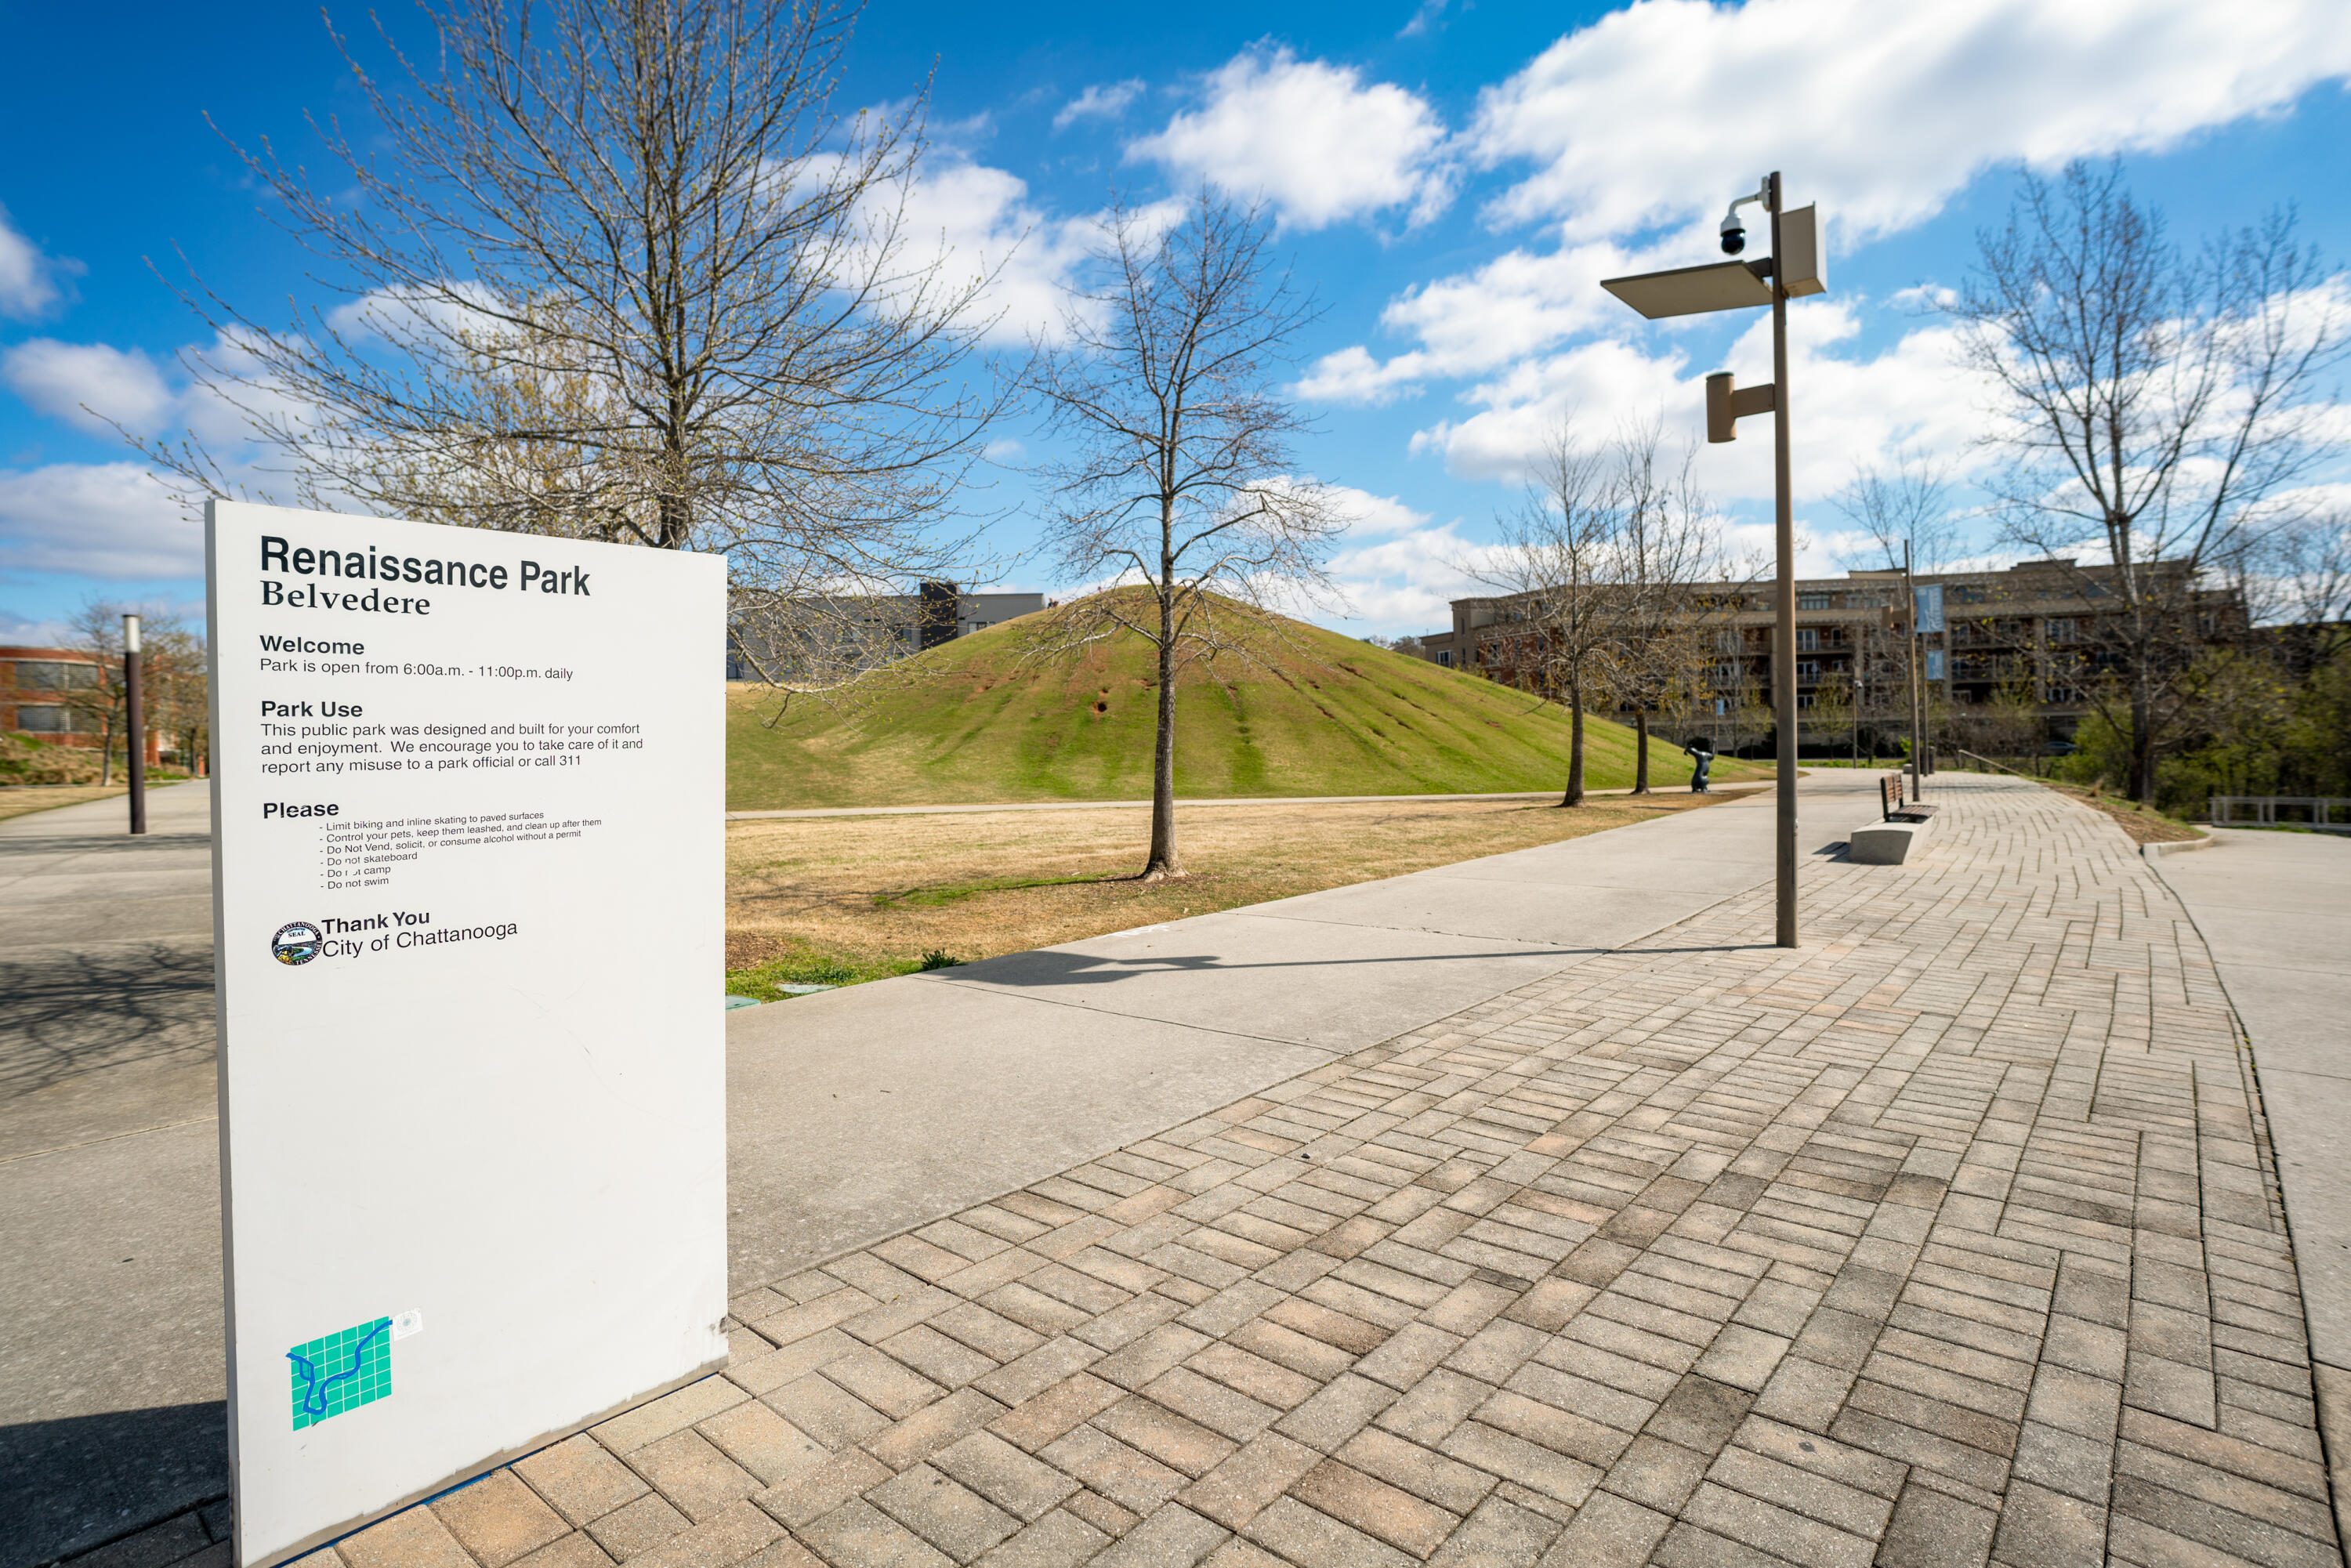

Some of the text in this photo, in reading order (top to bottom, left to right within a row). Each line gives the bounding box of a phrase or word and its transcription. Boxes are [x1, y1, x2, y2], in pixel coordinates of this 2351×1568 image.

[260, 534, 591, 596] Renaissance Park
[259, 580, 430, 615] Belvedere
[259, 634, 365, 655] Welcome
[260, 657, 299, 672] Park
[303, 659, 317, 672] is
[321, 663, 360, 676] open
[364, 661, 399, 675] from
[403, 663, 465, 676] 6:00a.m.
[479, 665, 542, 681] 11:00p.m.
[545, 667, 574, 683] daily
[261, 700, 364, 718] Park Use
[259, 722, 640, 740] This public park was designed and built for your comfort
[260, 738, 643, 758] and enjoyment. We encourage you to take care of it and
[262, 755, 580, 777] report any misuse to a park official or call 311
[263, 802, 339, 820] Please
[326, 821, 351, 831] Limit
[353, 820, 383, 831] biking
[386, 818, 404, 828] and
[407, 817, 432, 826] inline
[434, 816, 467, 826] skating
[480, 813, 506, 824] paved
[509, 812, 545, 820] surfaces
[326, 832, 364, 843] Control
[366, 832, 389, 842] your
[390, 830, 414, 841] pets,
[416, 829, 440, 839] keep
[441, 827, 465, 835] them
[467, 824, 504, 834] leashed,
[506, 823, 523, 831] and
[524, 822, 548, 831] clean
[549, 822, 560, 831] up
[561, 819, 581, 828] after
[327, 846, 342, 855] Do
[345, 844, 363, 853] Not
[364, 842, 393, 852] Vend,
[395, 840, 426, 850] solicit,
[440, 838, 481, 847] consume
[484, 834, 514, 844] alcohol
[516, 832, 546, 841] without
[556, 830, 581, 840] permit
[327, 857, 342, 867] Do
[345, 856, 360, 864] not
[363, 851, 418, 864] skateboard
[327, 869, 342, 878] Do
[364, 866, 391, 875] camp
[328, 881, 342, 889] Do
[345, 878, 361, 888] not
[364, 878, 389, 886] swim
[321, 911, 430, 935] Thank You
[322, 922, 518, 959] City of Chattanooga
